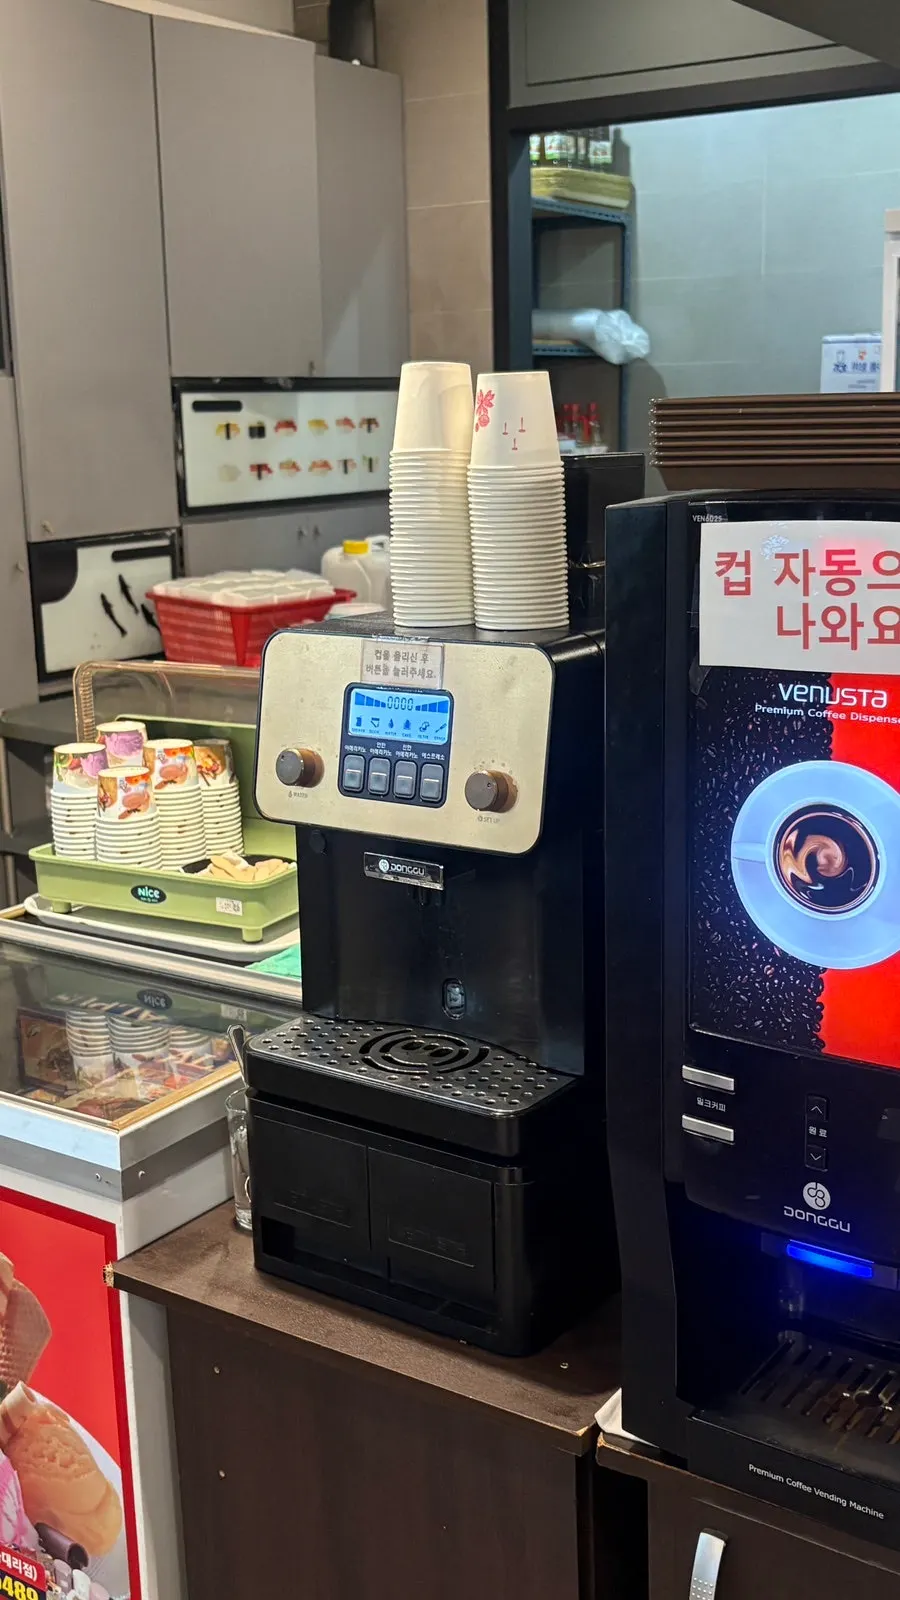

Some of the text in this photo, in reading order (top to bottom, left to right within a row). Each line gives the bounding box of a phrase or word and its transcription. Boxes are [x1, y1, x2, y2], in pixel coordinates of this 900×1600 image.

[692, 513, 722, 522] VEN6025
[714, 548, 900, 598] 컵 자동으
[776, 601, 900, 651] 나와요
[374, 649, 429, 664] 컵을 올리신 후
[365, 664, 390, 676] 버튼을
[386, 696, 414, 711] 0000
[755, 703, 804, 717] Premium
[808, 708, 847, 720] Coffee
[137, 886, 160, 899] Nice
[783, 1205, 851, 1233] DONGGU
[748, 1463, 885, 1520] Premium Coffee Vending Machine
[0, 1551, 38, 1582] 대리점)
[0, 1574, 39, 1600] 489
